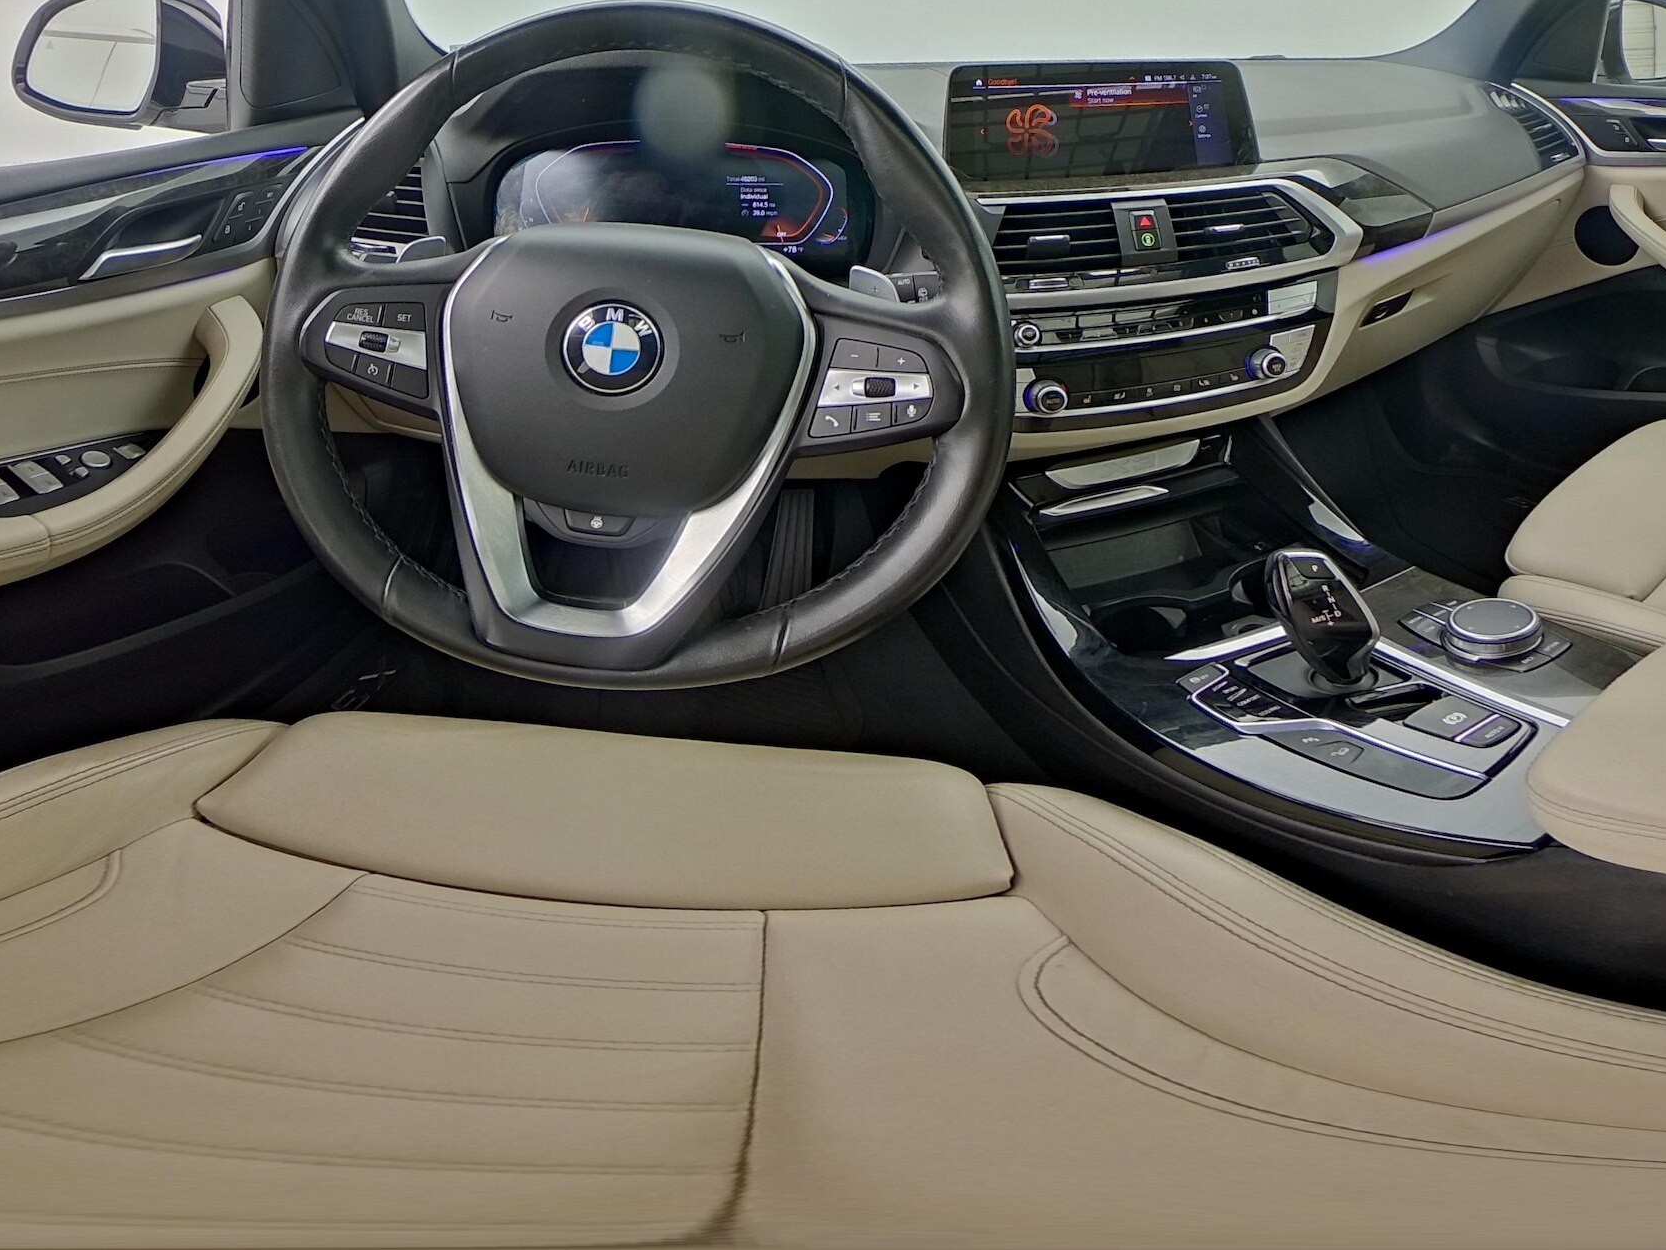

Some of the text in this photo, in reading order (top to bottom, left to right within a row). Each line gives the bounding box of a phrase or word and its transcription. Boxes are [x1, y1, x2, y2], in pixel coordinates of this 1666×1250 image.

[988, 78, 1018, 86] Goodbye!
[1086, 88, 1132, 97] Pre-ventilation
[347, 313, 375, 323] CANCEL
[397, 314, 412, 322] SET
[578, 307, 652, 337] BMW
[566, 459, 629, 479] AIRBAG
[1311, 564, 1318, 572] P
